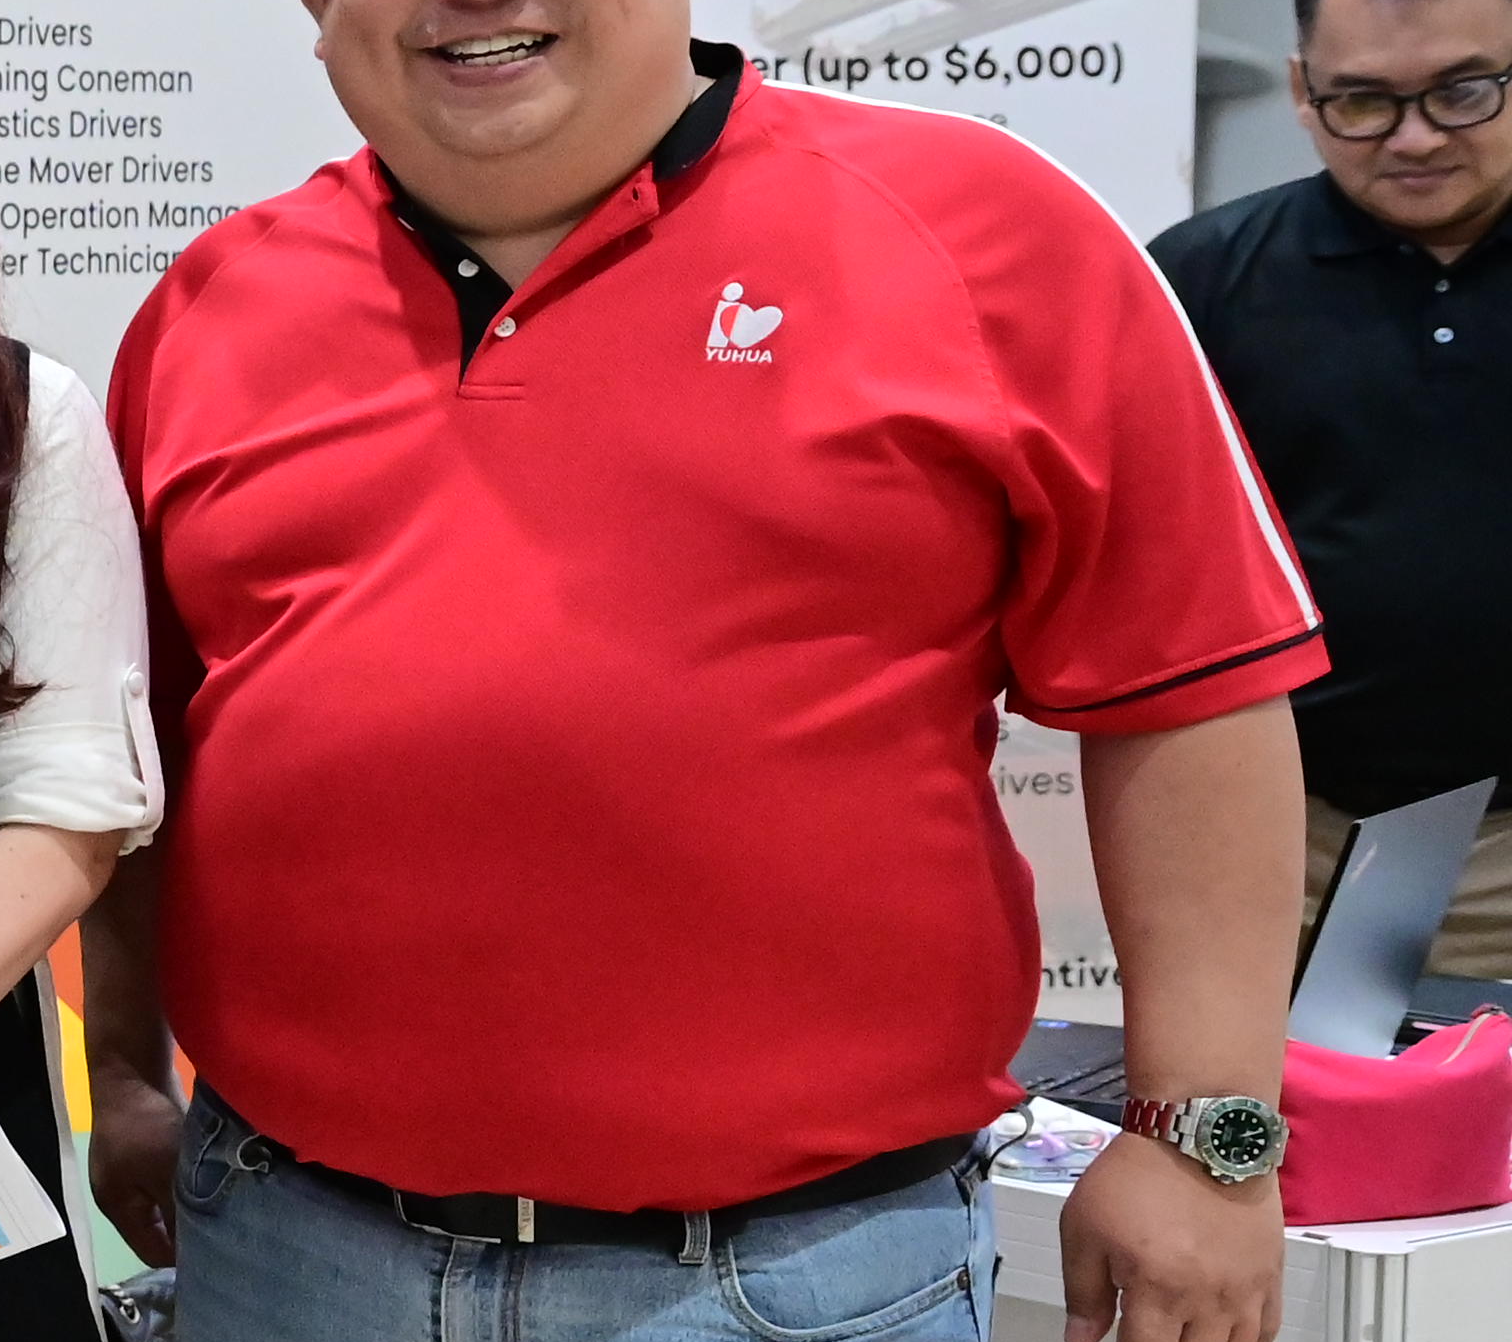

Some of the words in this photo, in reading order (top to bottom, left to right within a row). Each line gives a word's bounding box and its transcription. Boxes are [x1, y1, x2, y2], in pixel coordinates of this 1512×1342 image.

[56, 63, 194, 95] Coneman
[803, 47, 871, 90] (up
[884, 51, 930, 81] to
[944, 43, 1124, 87] $6,000)
[69, 109, 163, 140] Drivers
[29, 156, 114, 185] Mover
[121, 153, 215, 184] Drivers
[0, 198, 141, 240] Operation
[705, 346, 774, 364] YUHUA
